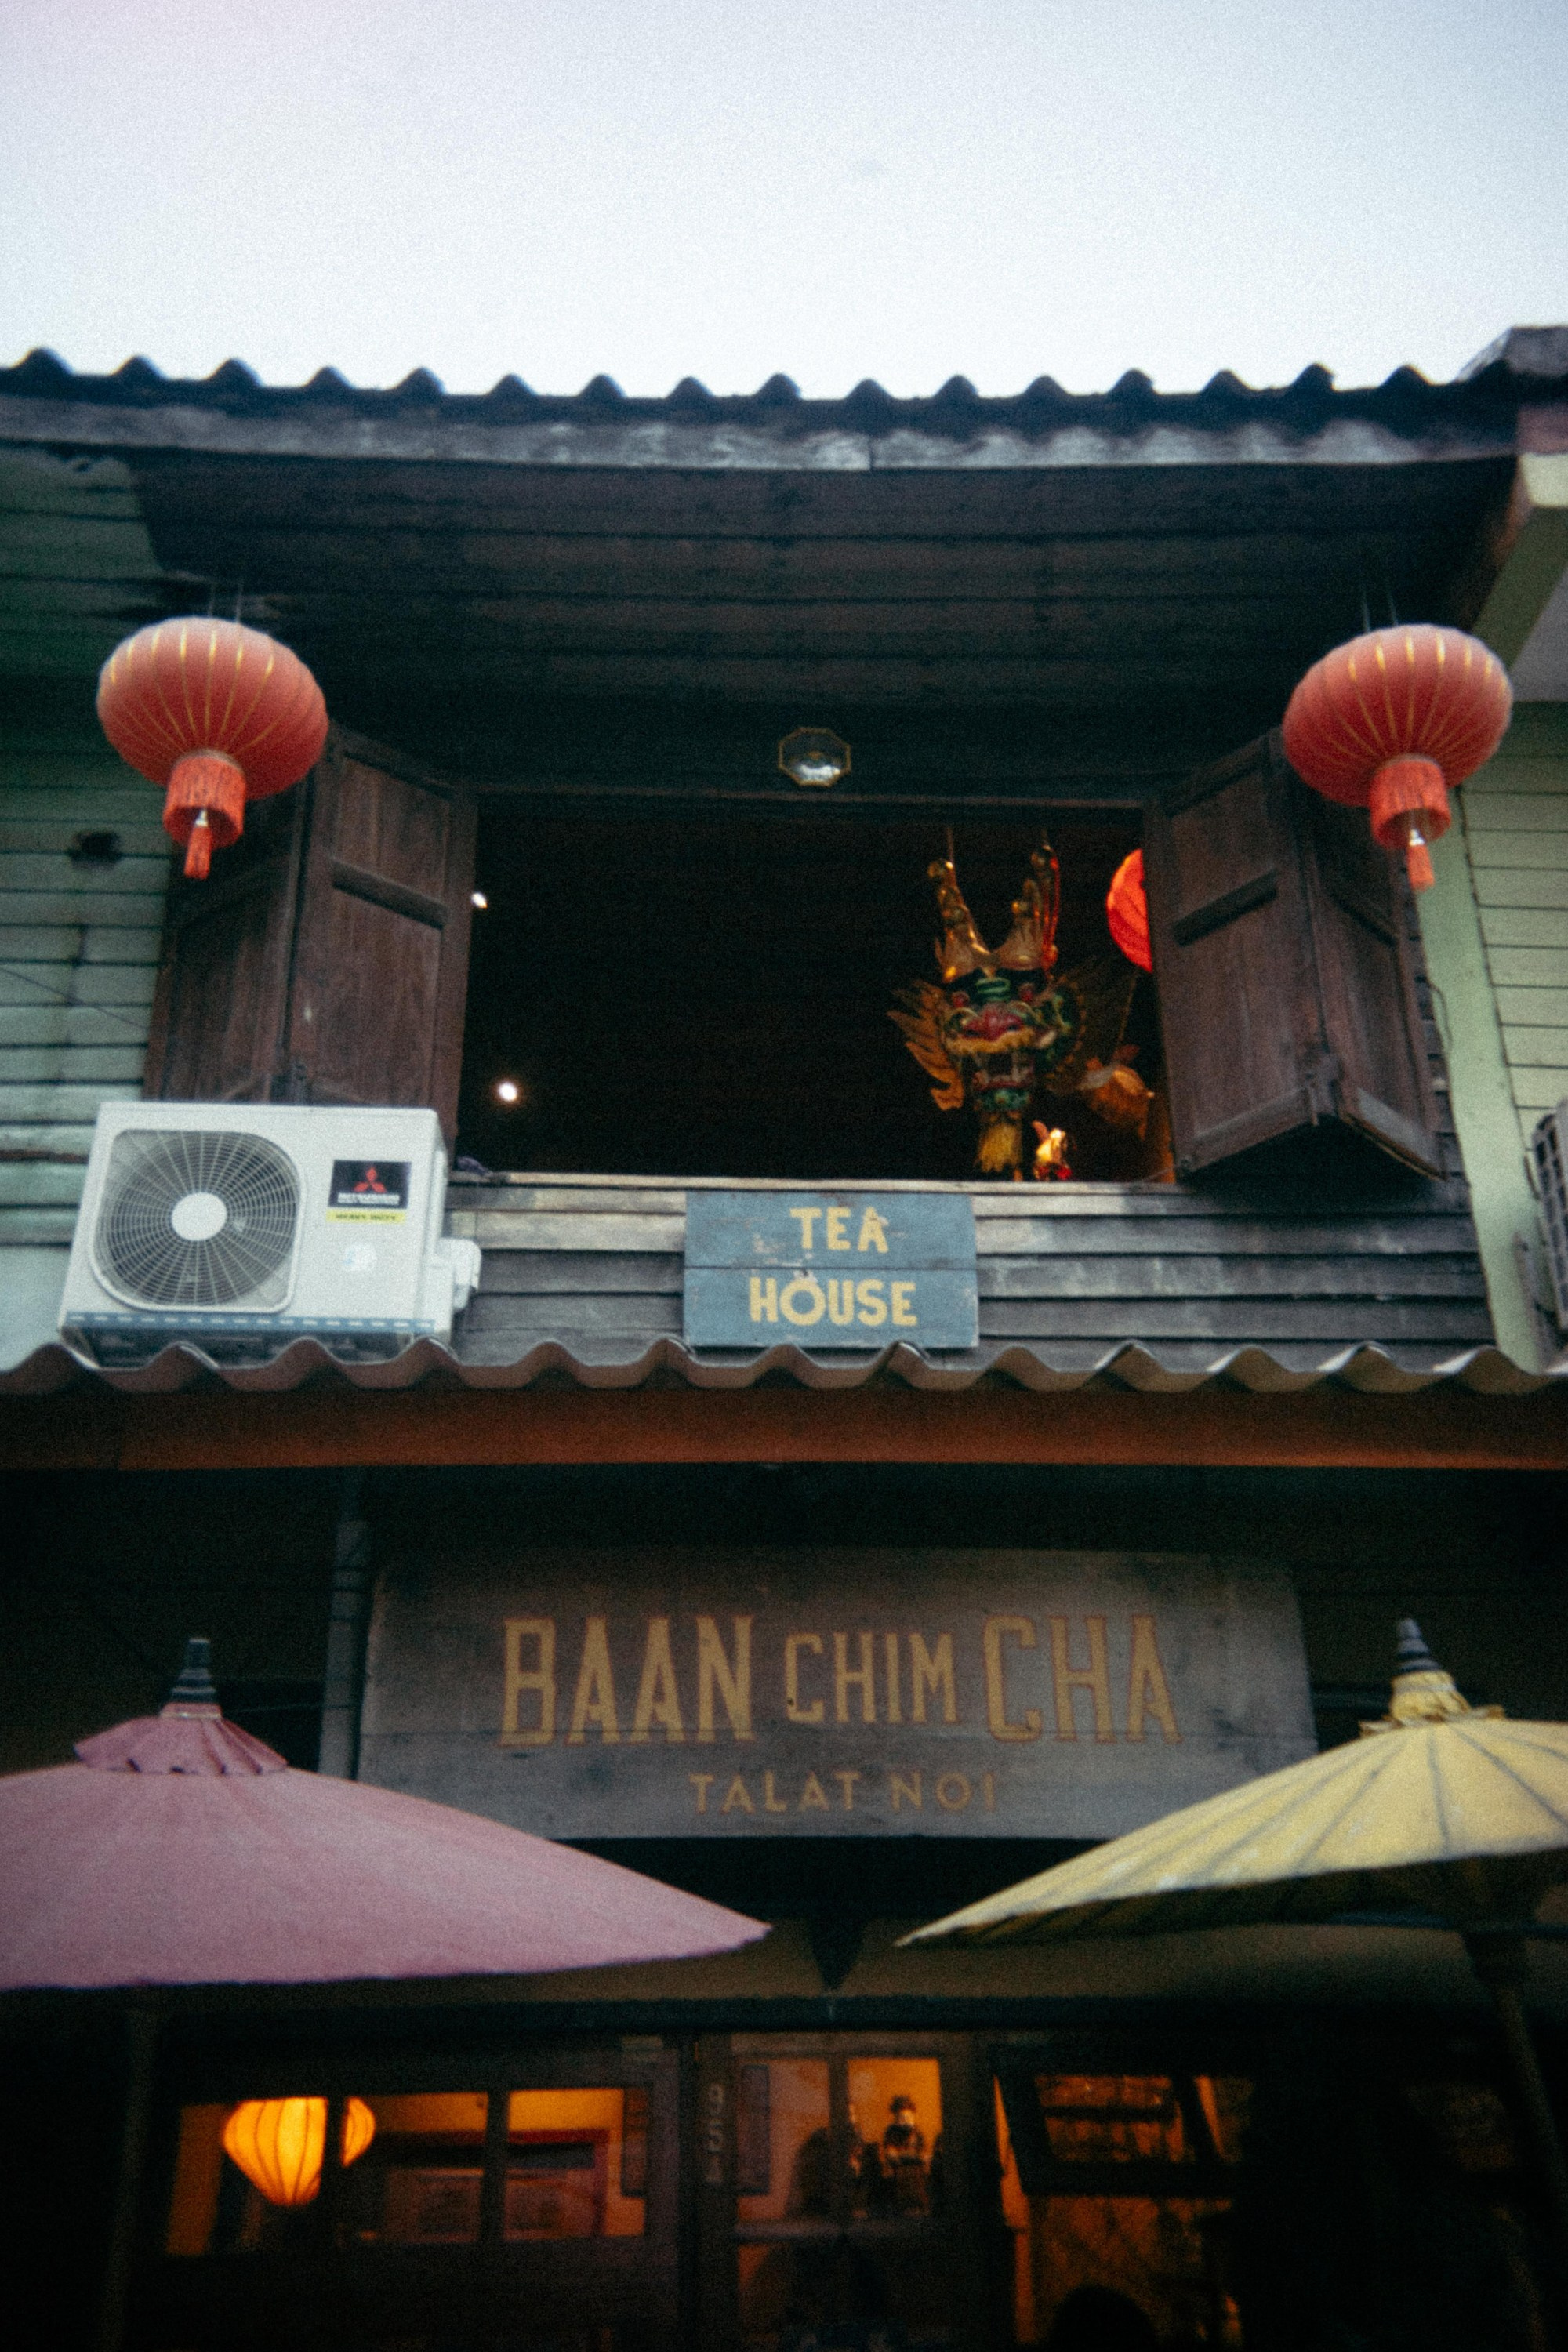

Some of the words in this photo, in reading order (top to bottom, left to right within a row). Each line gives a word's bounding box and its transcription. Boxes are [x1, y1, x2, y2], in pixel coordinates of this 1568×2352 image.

[789, 1207, 889, 1254] TEA
[749, 1277, 918, 1327] HOUSE
[498, 1615, 757, 1747] BAAN
[784, 1630, 960, 1726] CHIM
[981, 1614, 1184, 1745] CHA
[688, 1770, 862, 1816] TALAT
[889, 1769, 998, 1813] NOI
